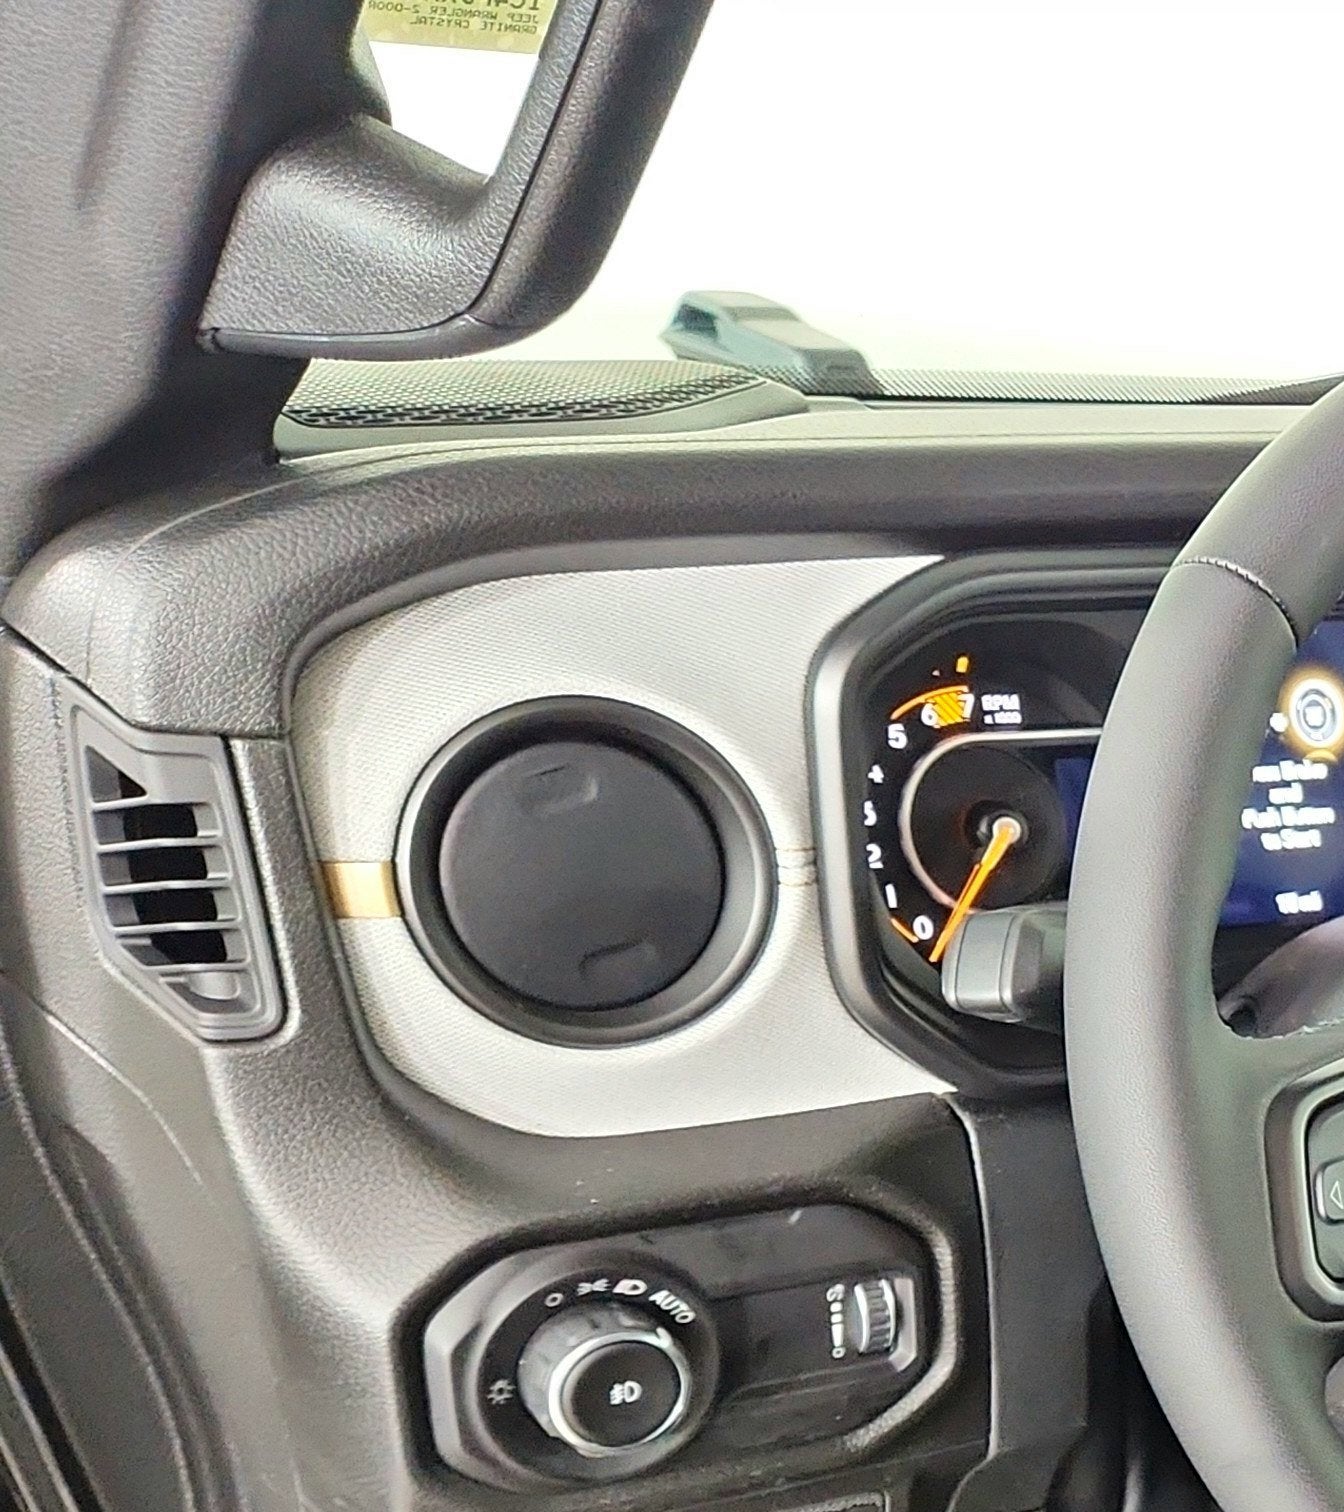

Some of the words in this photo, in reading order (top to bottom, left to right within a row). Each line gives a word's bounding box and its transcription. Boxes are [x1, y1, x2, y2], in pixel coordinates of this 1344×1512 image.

[887, 722, 908, 749] 5
[912, 915, 934, 941] 0
[648, 1289, 696, 1325] AUTO
